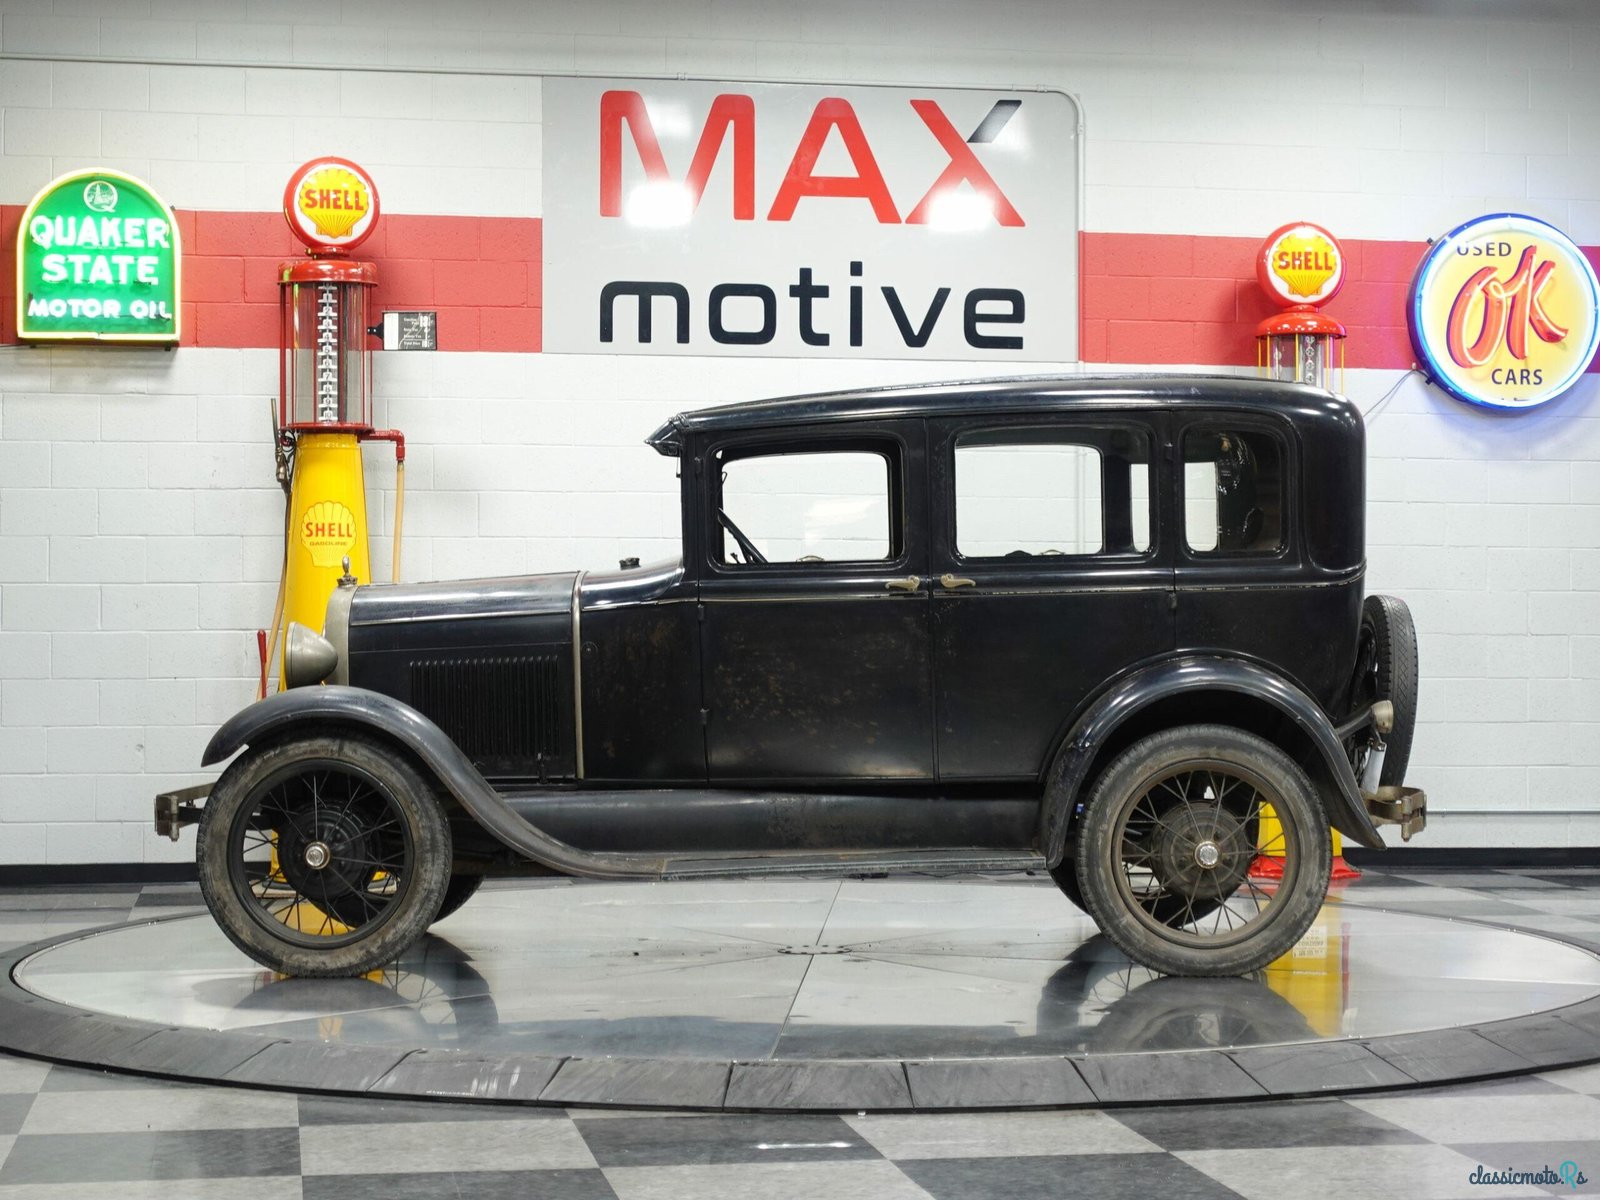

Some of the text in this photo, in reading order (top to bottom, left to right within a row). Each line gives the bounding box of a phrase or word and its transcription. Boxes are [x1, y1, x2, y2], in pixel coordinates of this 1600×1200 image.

[600, 90, 1025, 228] MAX
[304, 188, 365, 211] SHELL
[29, 214, 171, 250] QUAKER
[1277, 251, 1333, 271] SHELL
[1456, 242, 1512, 257] USED
[41, 253, 159, 285] STATE
[27, 298, 173, 320] MOTOR OIL
[600, 260, 1025, 350] motive
[1446, 244, 1569, 369] OK
[1491, 368, 1543, 385] CARS
[305, 522, 353, 538] SHELL
